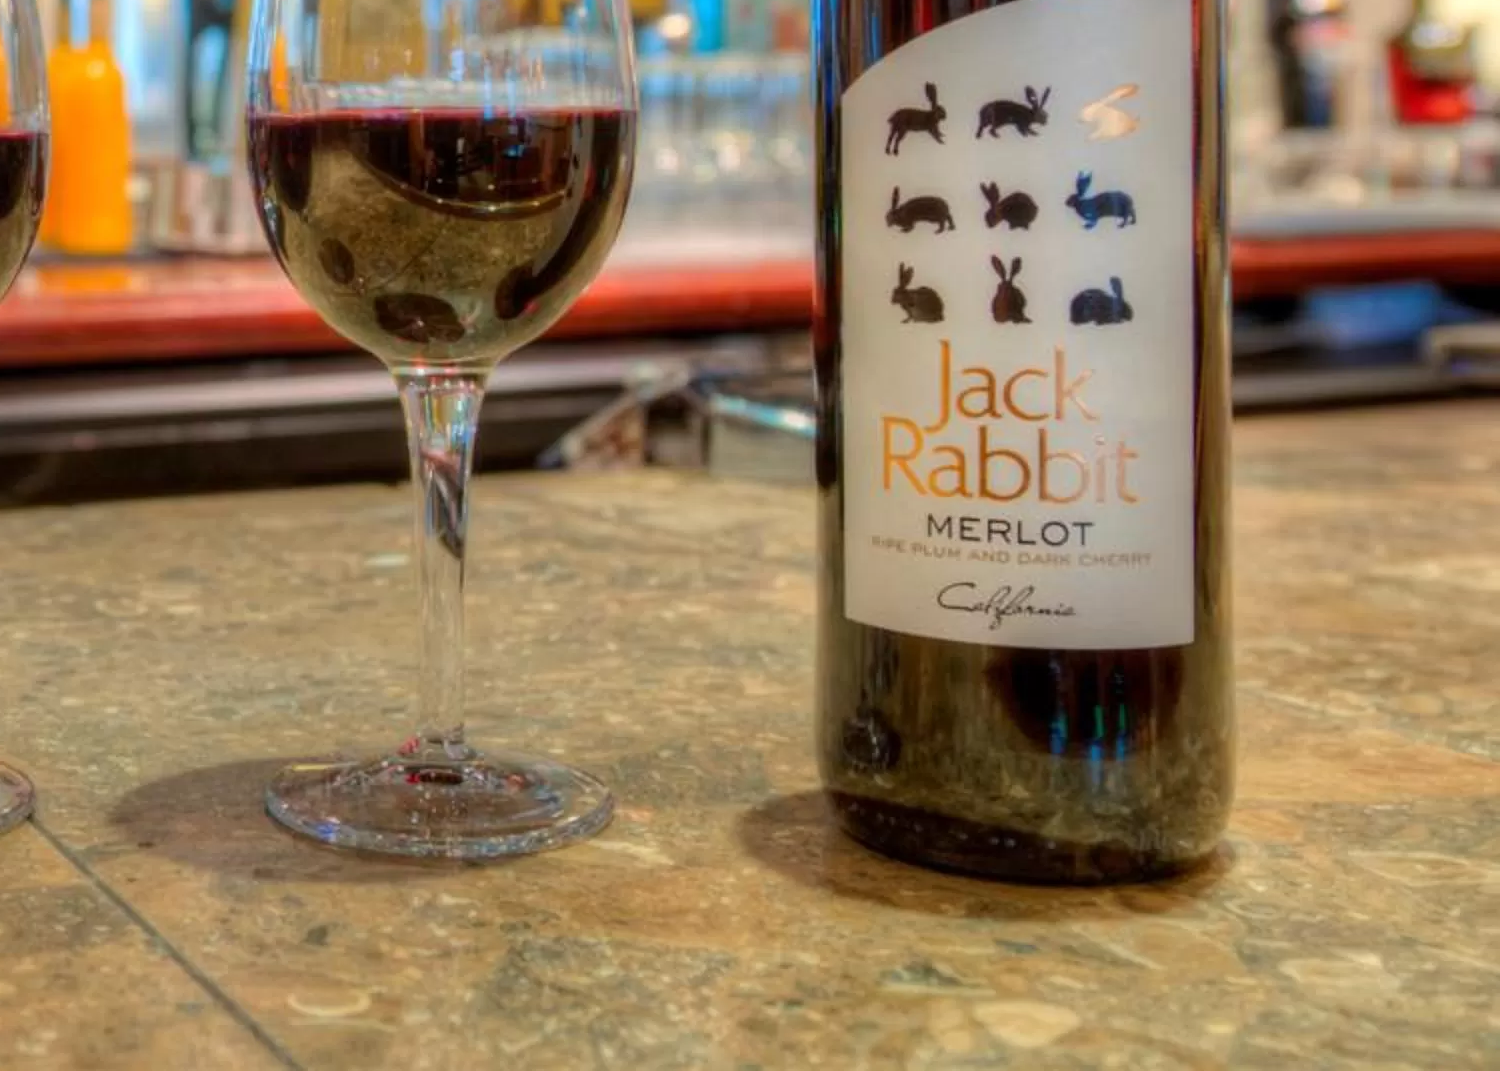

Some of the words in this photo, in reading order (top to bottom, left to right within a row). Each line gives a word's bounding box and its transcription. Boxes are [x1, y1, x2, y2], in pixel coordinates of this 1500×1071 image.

[922, 337, 1099, 434] Jack
[881, 415, 1141, 505] Rabbit
[911, 541, 962, 560] PLUM
[967, 549, 1011, 565] AND
[1016, 551, 1070, 567] DARK
[1078, 552, 1152, 569] CHERRY
[926, 513, 1095, 547] MERLOT
[936, 581, 1077, 631] California
